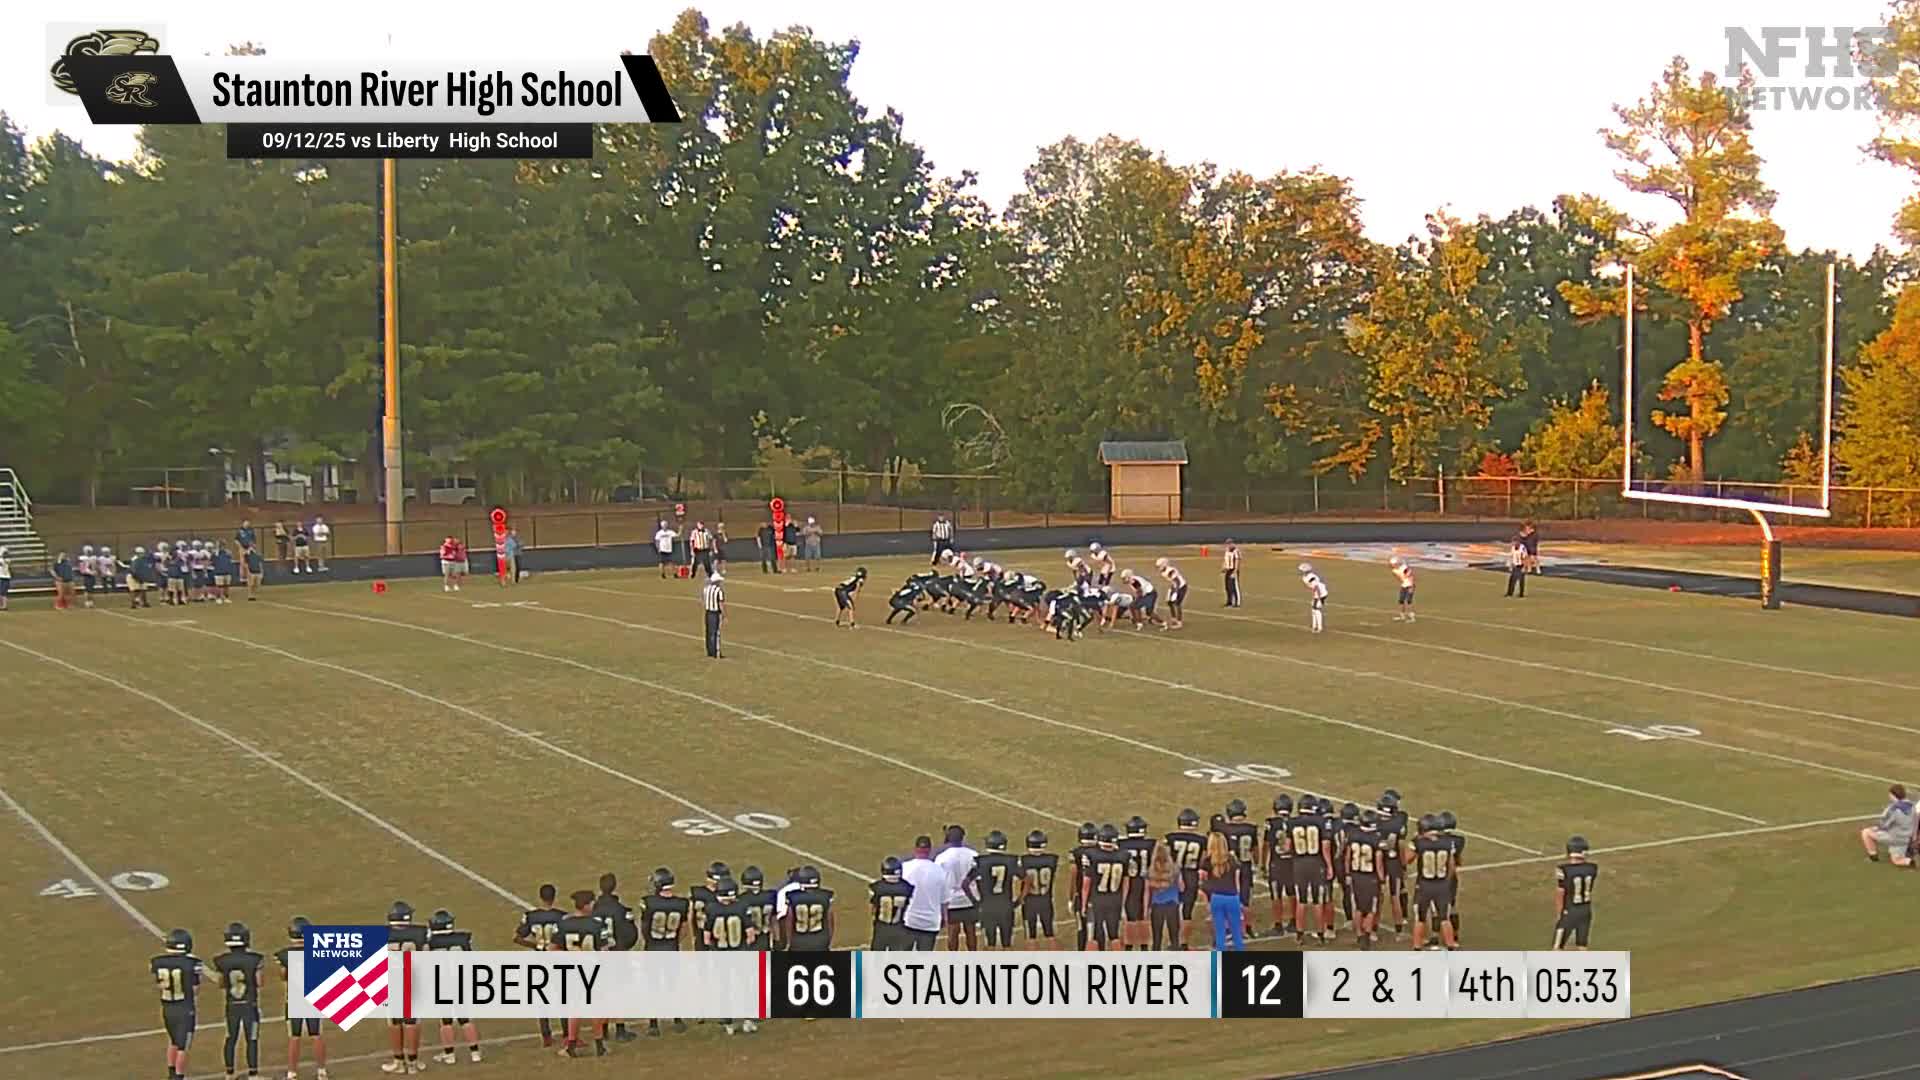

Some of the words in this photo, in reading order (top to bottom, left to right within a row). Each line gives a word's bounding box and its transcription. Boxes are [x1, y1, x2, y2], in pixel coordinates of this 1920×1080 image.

[1184, 764, 1292, 783] 20
[672, 812, 791, 836] 30
[1174, 840, 1201, 869] 72
[40, 871, 169, 898] 40
[991, 865, 1006, 894] 7
[713, 916, 742, 949] 40
[157, 968, 185, 1001] 21
